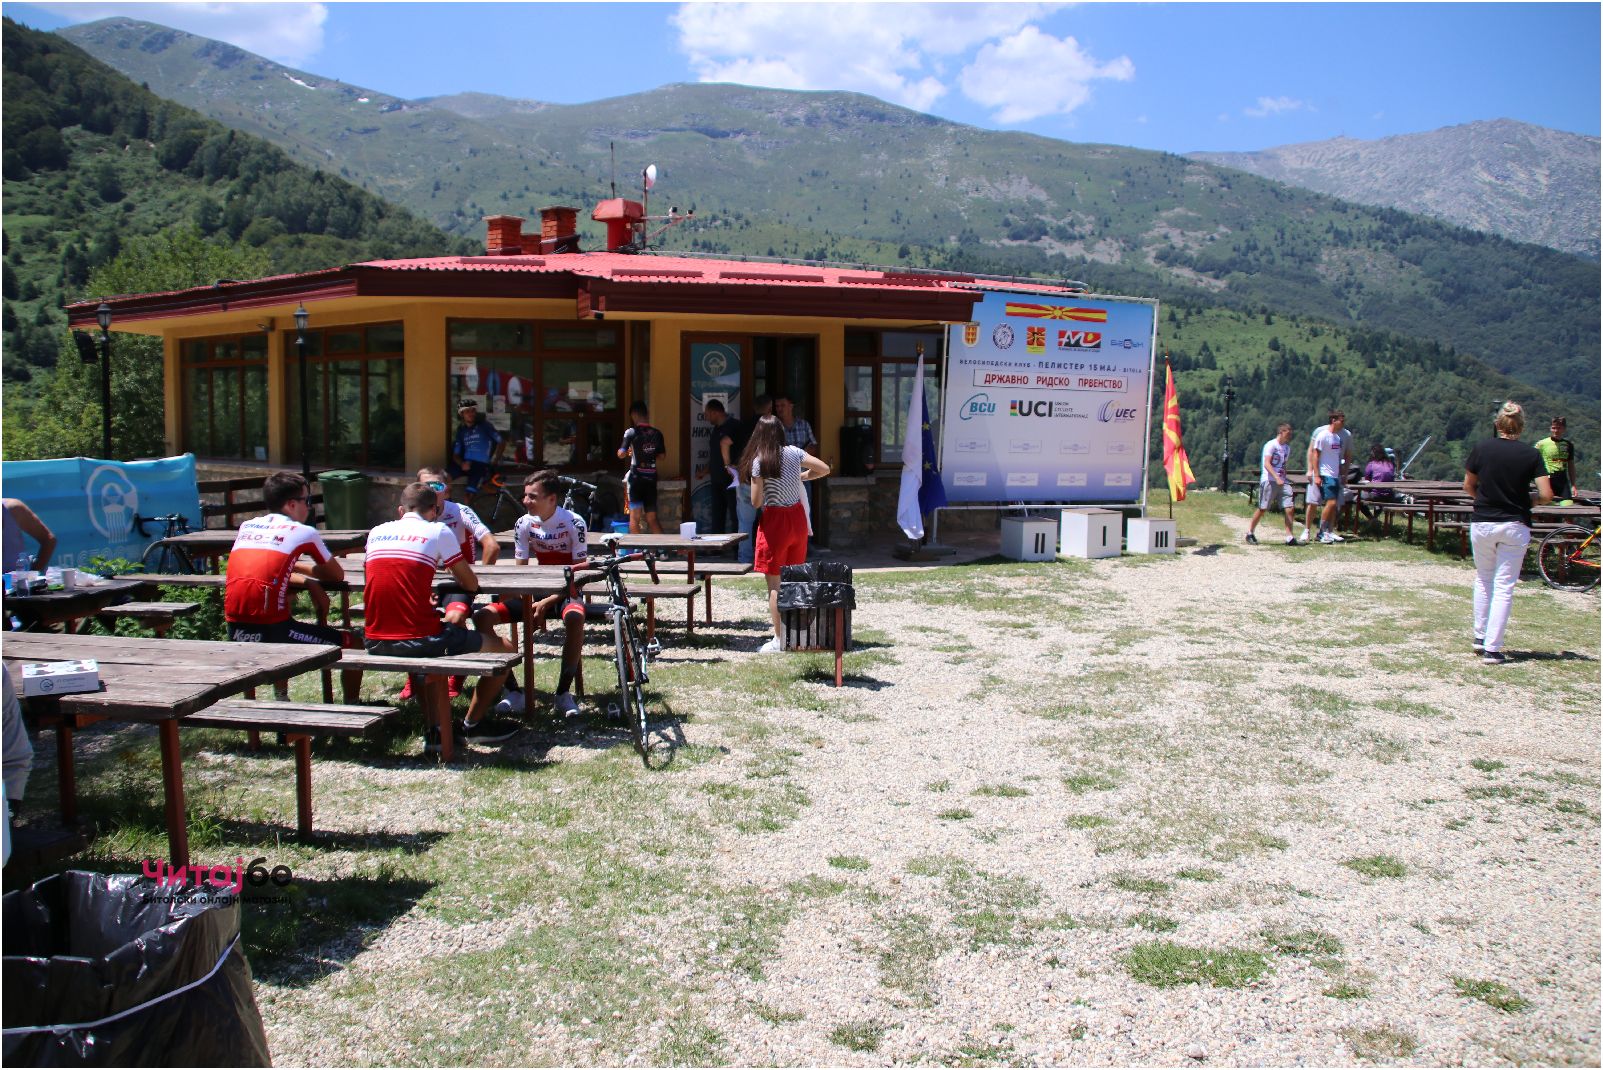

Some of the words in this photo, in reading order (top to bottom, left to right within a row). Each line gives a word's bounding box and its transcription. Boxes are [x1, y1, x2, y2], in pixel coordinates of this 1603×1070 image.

[1038, 361, 1085, 371] ПЕЛИСТЕР
[1089, 364, 1098, 372] 15
[1099, 364, 1117, 373] МАЈ
[984, 373, 1029, 386] ДРЖАВНО
[1036, 375, 1070, 388] РИДСКО
[1078, 377, 1123, 389] ПРВЕНСТВО
[970, 401, 996, 413] BCU
[1018, 399, 1053, 418] UCI
[1115, 408, 1137, 419] UEC
[1034, 532, 1046, 554] II
[1154, 530, 1169, 548] III
